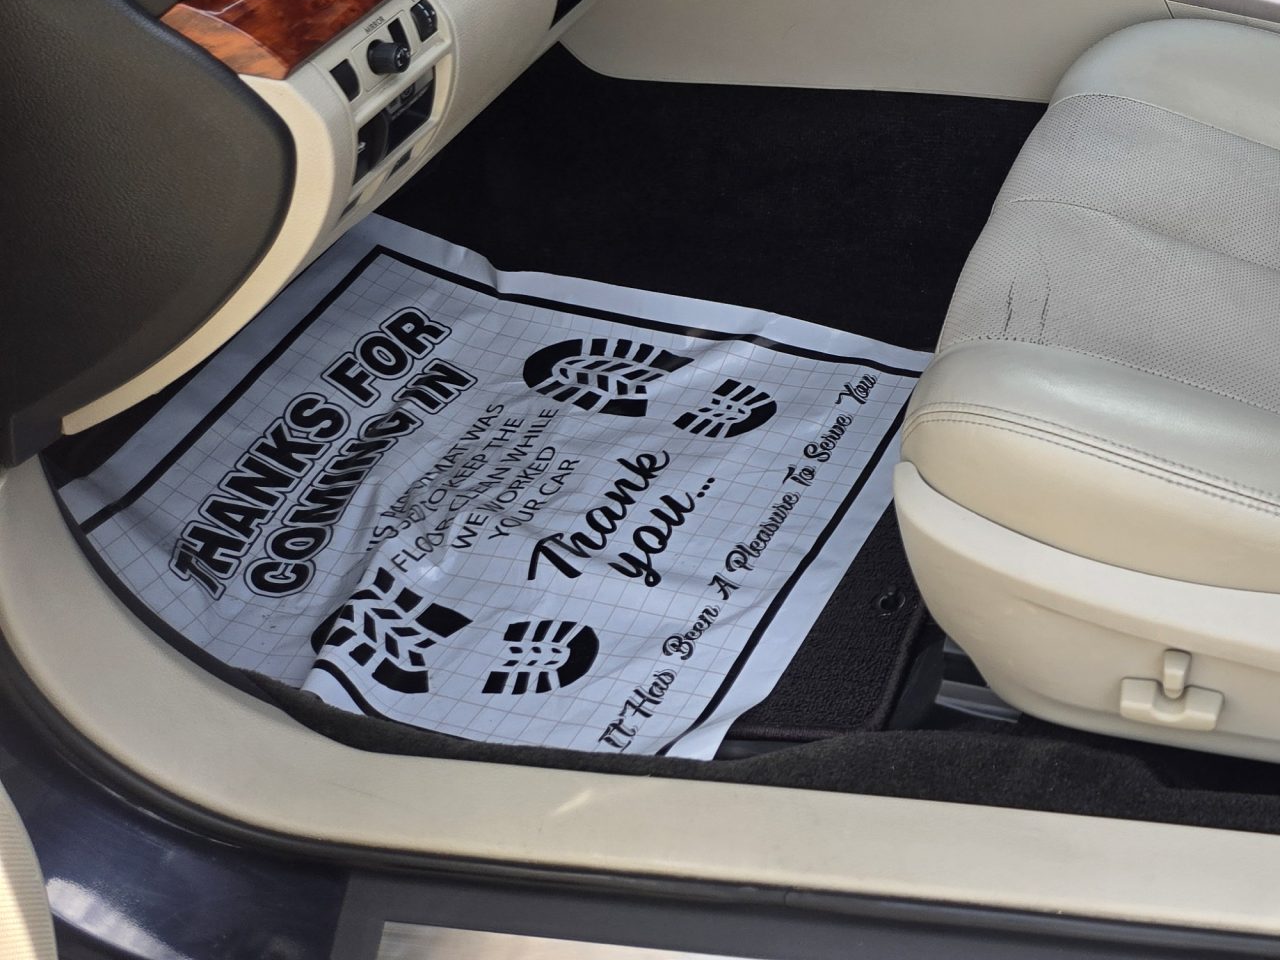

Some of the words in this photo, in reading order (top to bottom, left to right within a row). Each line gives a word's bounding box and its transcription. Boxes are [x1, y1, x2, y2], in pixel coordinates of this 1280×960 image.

[169, 392, 351, 600] THANKS
[320, 307, 452, 407] FOR
[442, 453, 489, 489] KEEP
[483, 417, 524, 451] THE
[449, 467, 511, 513] CLEAN
[502, 408, 559, 463] WHILE
[460, 404, 505, 442] WAS
[244, 407, 424, 598] COMING
[392, 358, 478, 414] IN
[451, 512, 489, 549] WE
[477, 446, 556, 514] WORKED
[488, 498, 547, 540] YOUR
[539, 458, 581, 497] CAR
[527, 450, 670, 581] Thank
[618, 668, 678, 718] Has
[662, 605, 721, 660] Been
[708, 572, 742, 600] A
[725, 491, 800, 572] Pleasure
[782, 464, 816, 486] To
[803, 413, 855, 463] Serve
[835, 373, 878, 405] You
